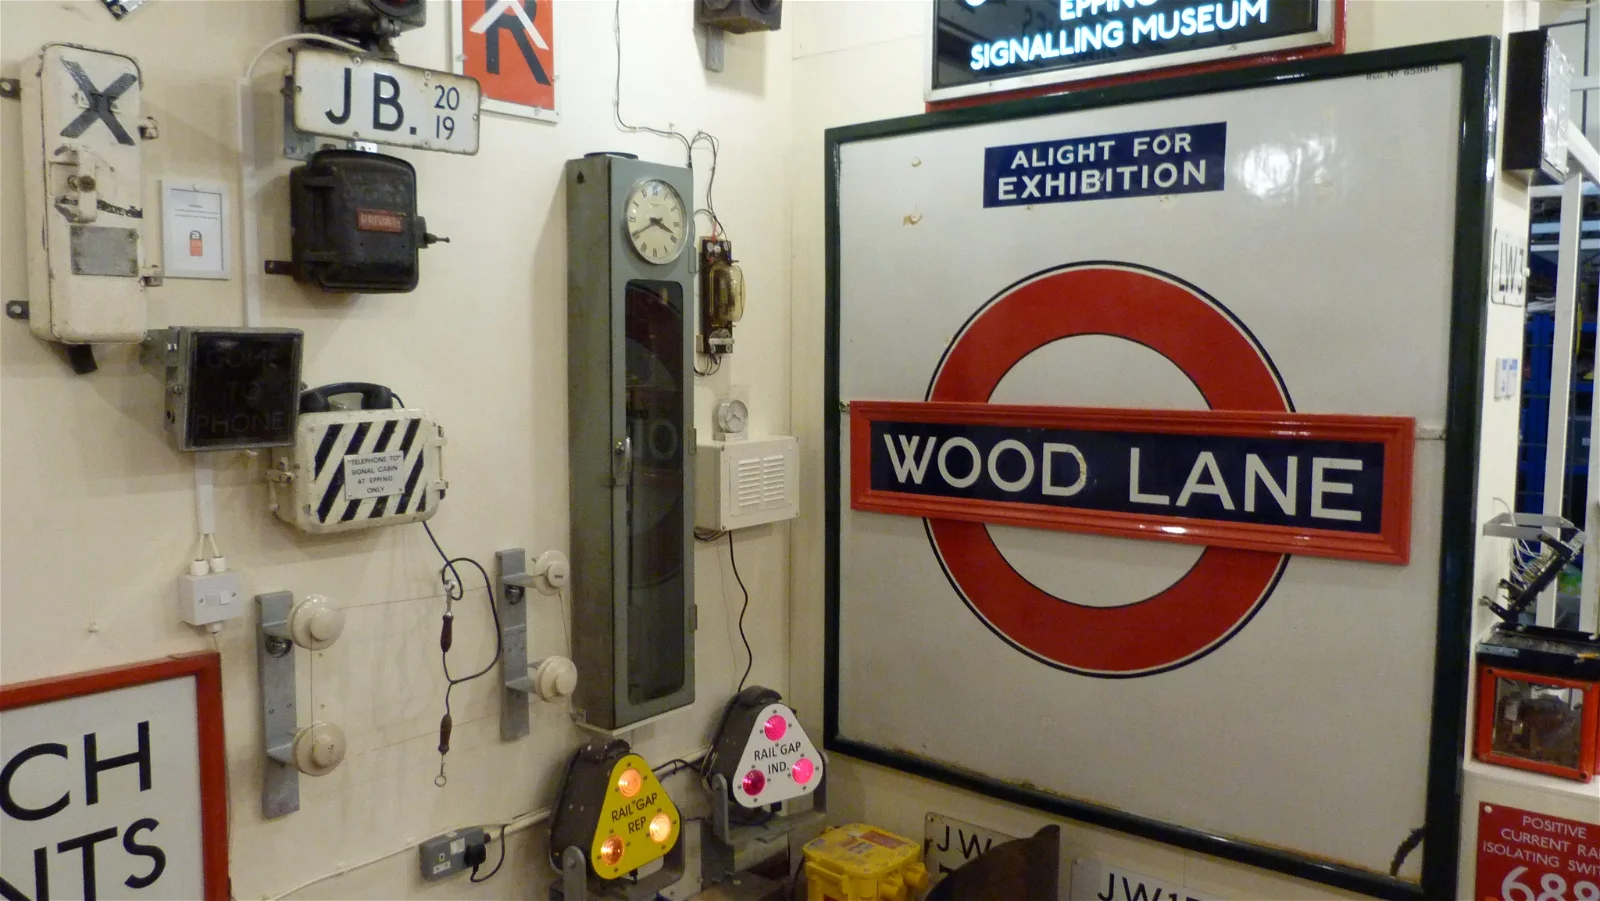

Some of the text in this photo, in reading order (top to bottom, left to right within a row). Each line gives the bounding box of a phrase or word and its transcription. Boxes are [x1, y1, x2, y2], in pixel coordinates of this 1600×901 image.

[1060, 0, 1158, 21] EPPI
[969, 0, 1268, 71] SIGNALLING MUSEUM
[434, 84, 460, 111] 20
[436, 115, 455, 140] 19
[1010, 133, 1192, 169] ALIGHT FOR
[998, 159, 1207, 201] EXHIBITION
[194, 411, 286, 435] PHONE
[351, 456, 388, 466] TELEPHONE
[351, 465, 398, 476] SIGNAL CABIN
[366, 485, 385, 494] ONLY
[369, 475, 393, 484] EPPING
[883, 433, 1364, 522] WOOD LANE
[754, 741, 801, 761] RAIL GAP
[0, 720, 152, 822] CH
[768, 761, 790, 775] IND.
[611, 792, 658, 822] RAIL GAP
[627, 816, 647, 834] REP
[1522, 815, 1587, 840] POSITIVE
[1501, 827, 1572, 853] CURRENT
[1482, 840, 1560, 868] ISOLATING
